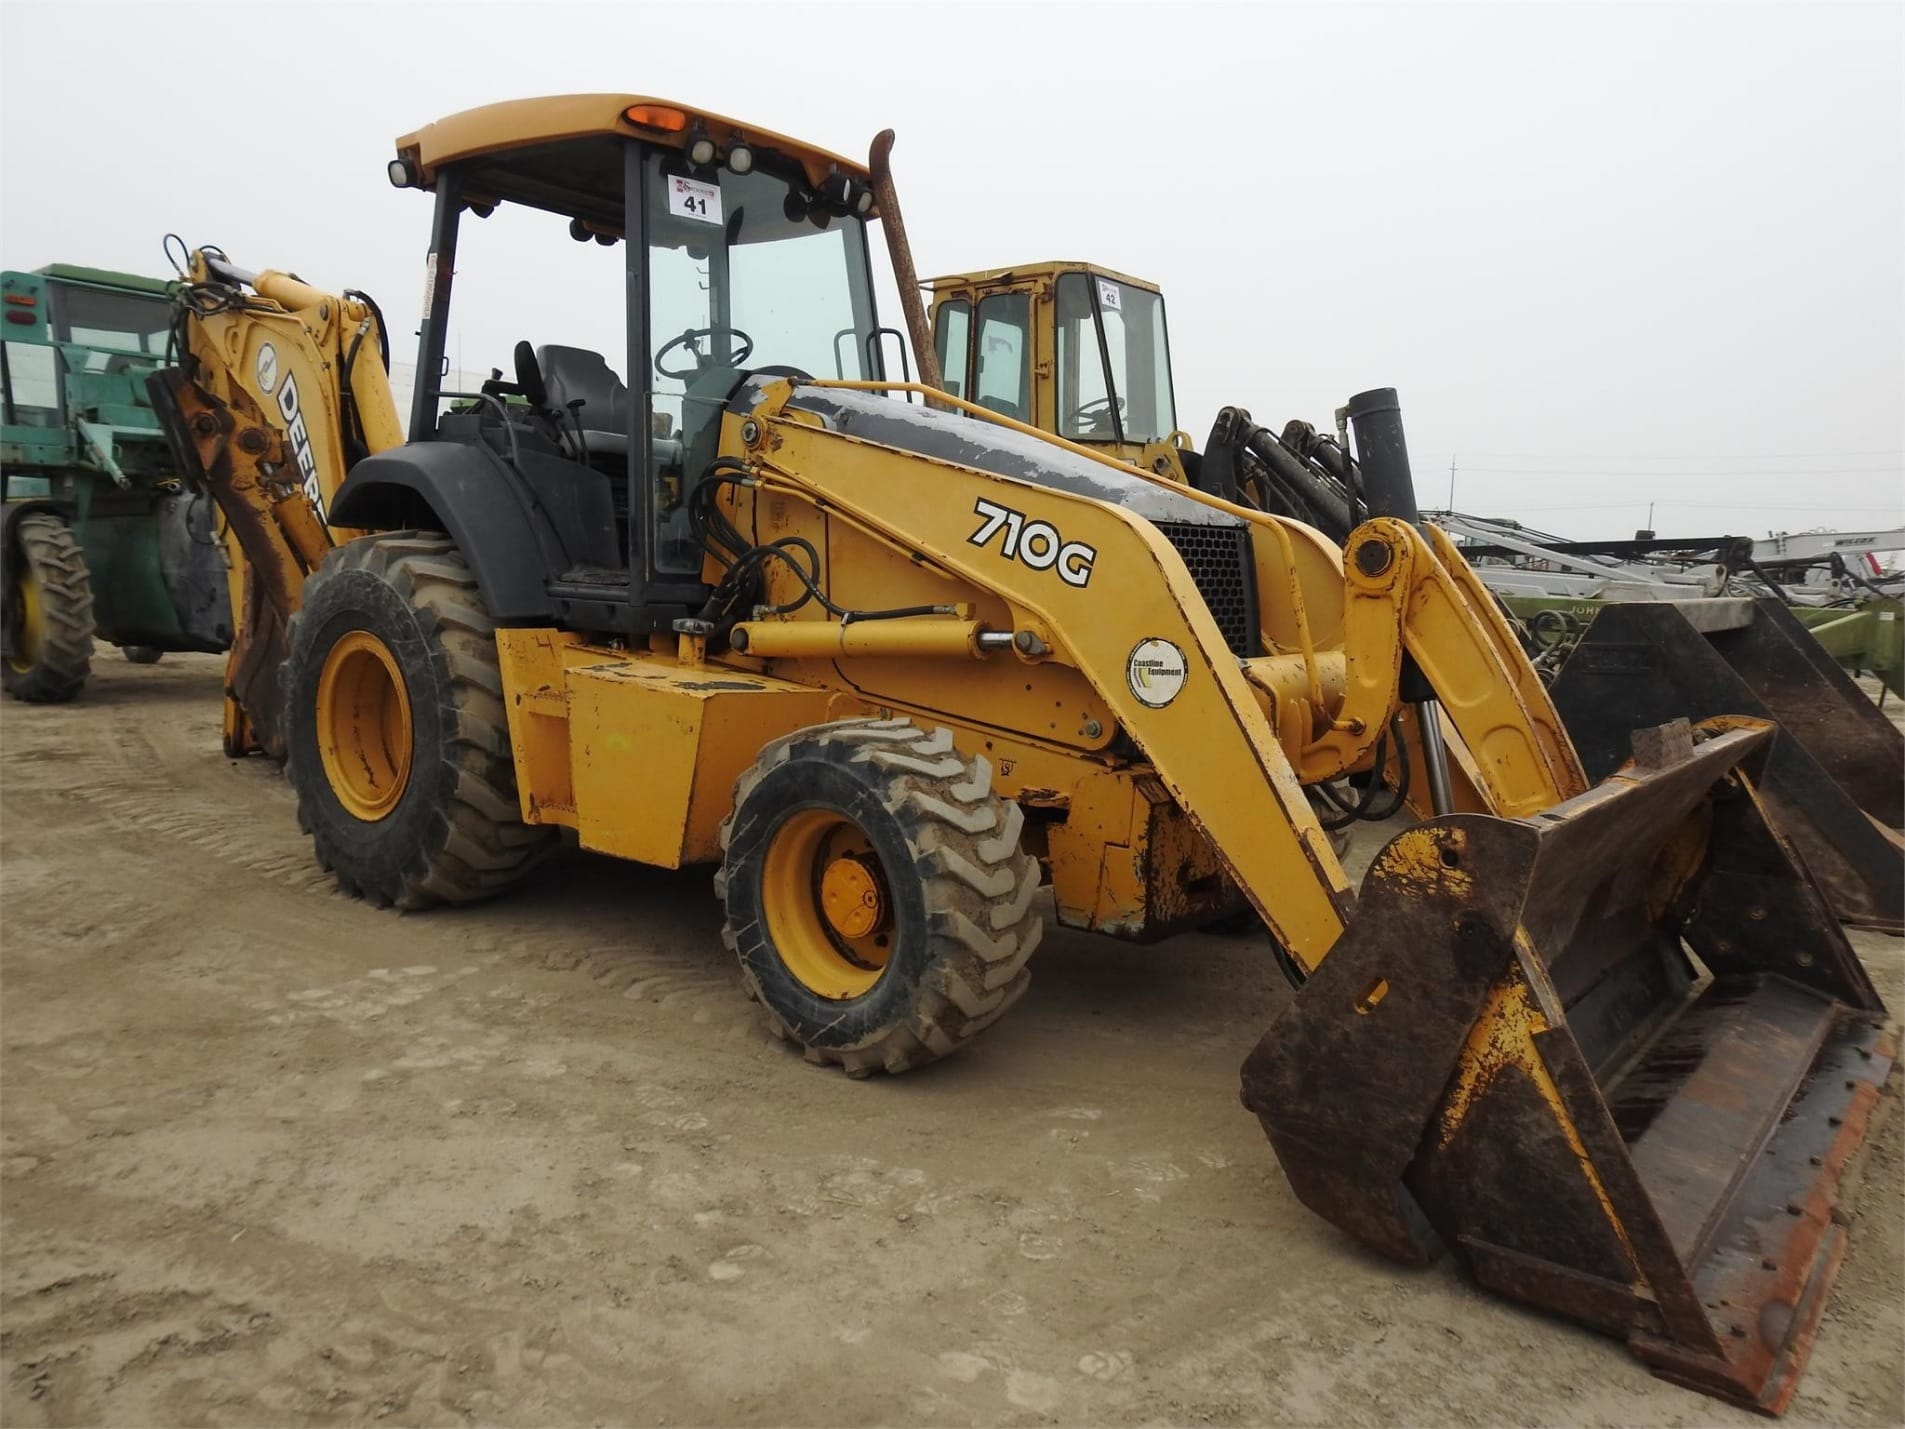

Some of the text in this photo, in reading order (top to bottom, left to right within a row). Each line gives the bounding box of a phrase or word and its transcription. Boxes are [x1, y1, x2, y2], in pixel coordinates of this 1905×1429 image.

[684, 195, 706, 215] 41
[1105, 293, 1116, 304] 42
[967, 496, 1098, 588] 710G
[1133, 658, 1164, 668] Coastline
[1148, 667, 1182, 677] Equipment
